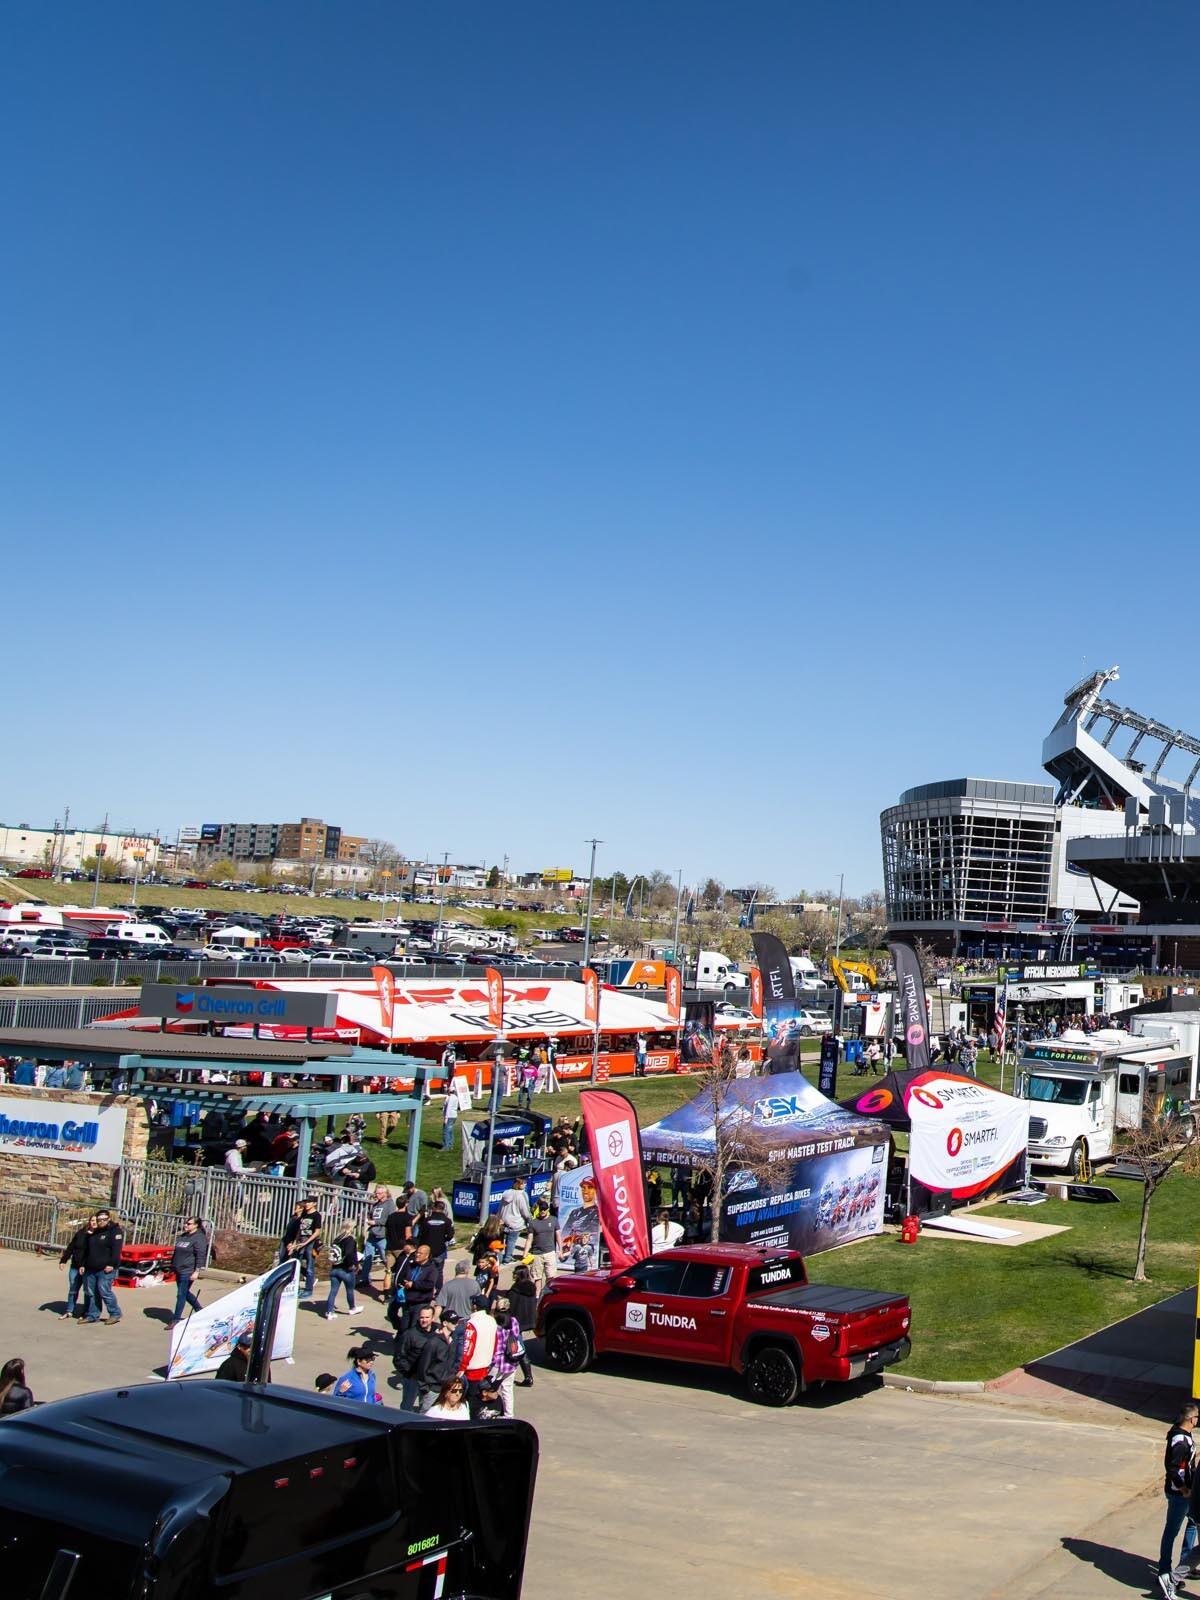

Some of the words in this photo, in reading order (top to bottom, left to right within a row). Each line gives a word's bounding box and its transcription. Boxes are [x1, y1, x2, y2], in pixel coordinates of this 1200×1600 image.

[1064, 911, 1073, 920] 10
[1024, 966, 1045, 979] OFFICIAL
[198, 994, 256, 1015] Chevron
[257, 999, 287, 1017] Grill
[1067, 1053, 1088, 1061] FAME
[0, 1113, 60, 1139] hevron
[61, 1120, 99, 1144] Grill
[25, 1140, 52, 1149] EMPOWER
[51, 1143, 65, 1151] FIELD
[787, 1143, 815, 1160] MASTER
[816, 1141, 833, 1154] TEST
[834, 1136, 856, 1149] TRACK
[656, 1153, 690, 1167] REPLICA
[459, 1191, 474, 1200] BUD
[561, 1190, 579, 1199] FULL
[769, 1191, 793, 1206] REPLICA
[793, 1188, 811, 1201] BIKES
[455, 1198, 476, 1207] LIGHT
[736, 1211, 756, 1227] NOW
[765, 1237, 779, 1247] THEM
[760, 1268, 792, 1285] TUNDRA
[649, 1312, 697, 1330] TUNDRA
[407, 1534, 440, 1556] 8016821
